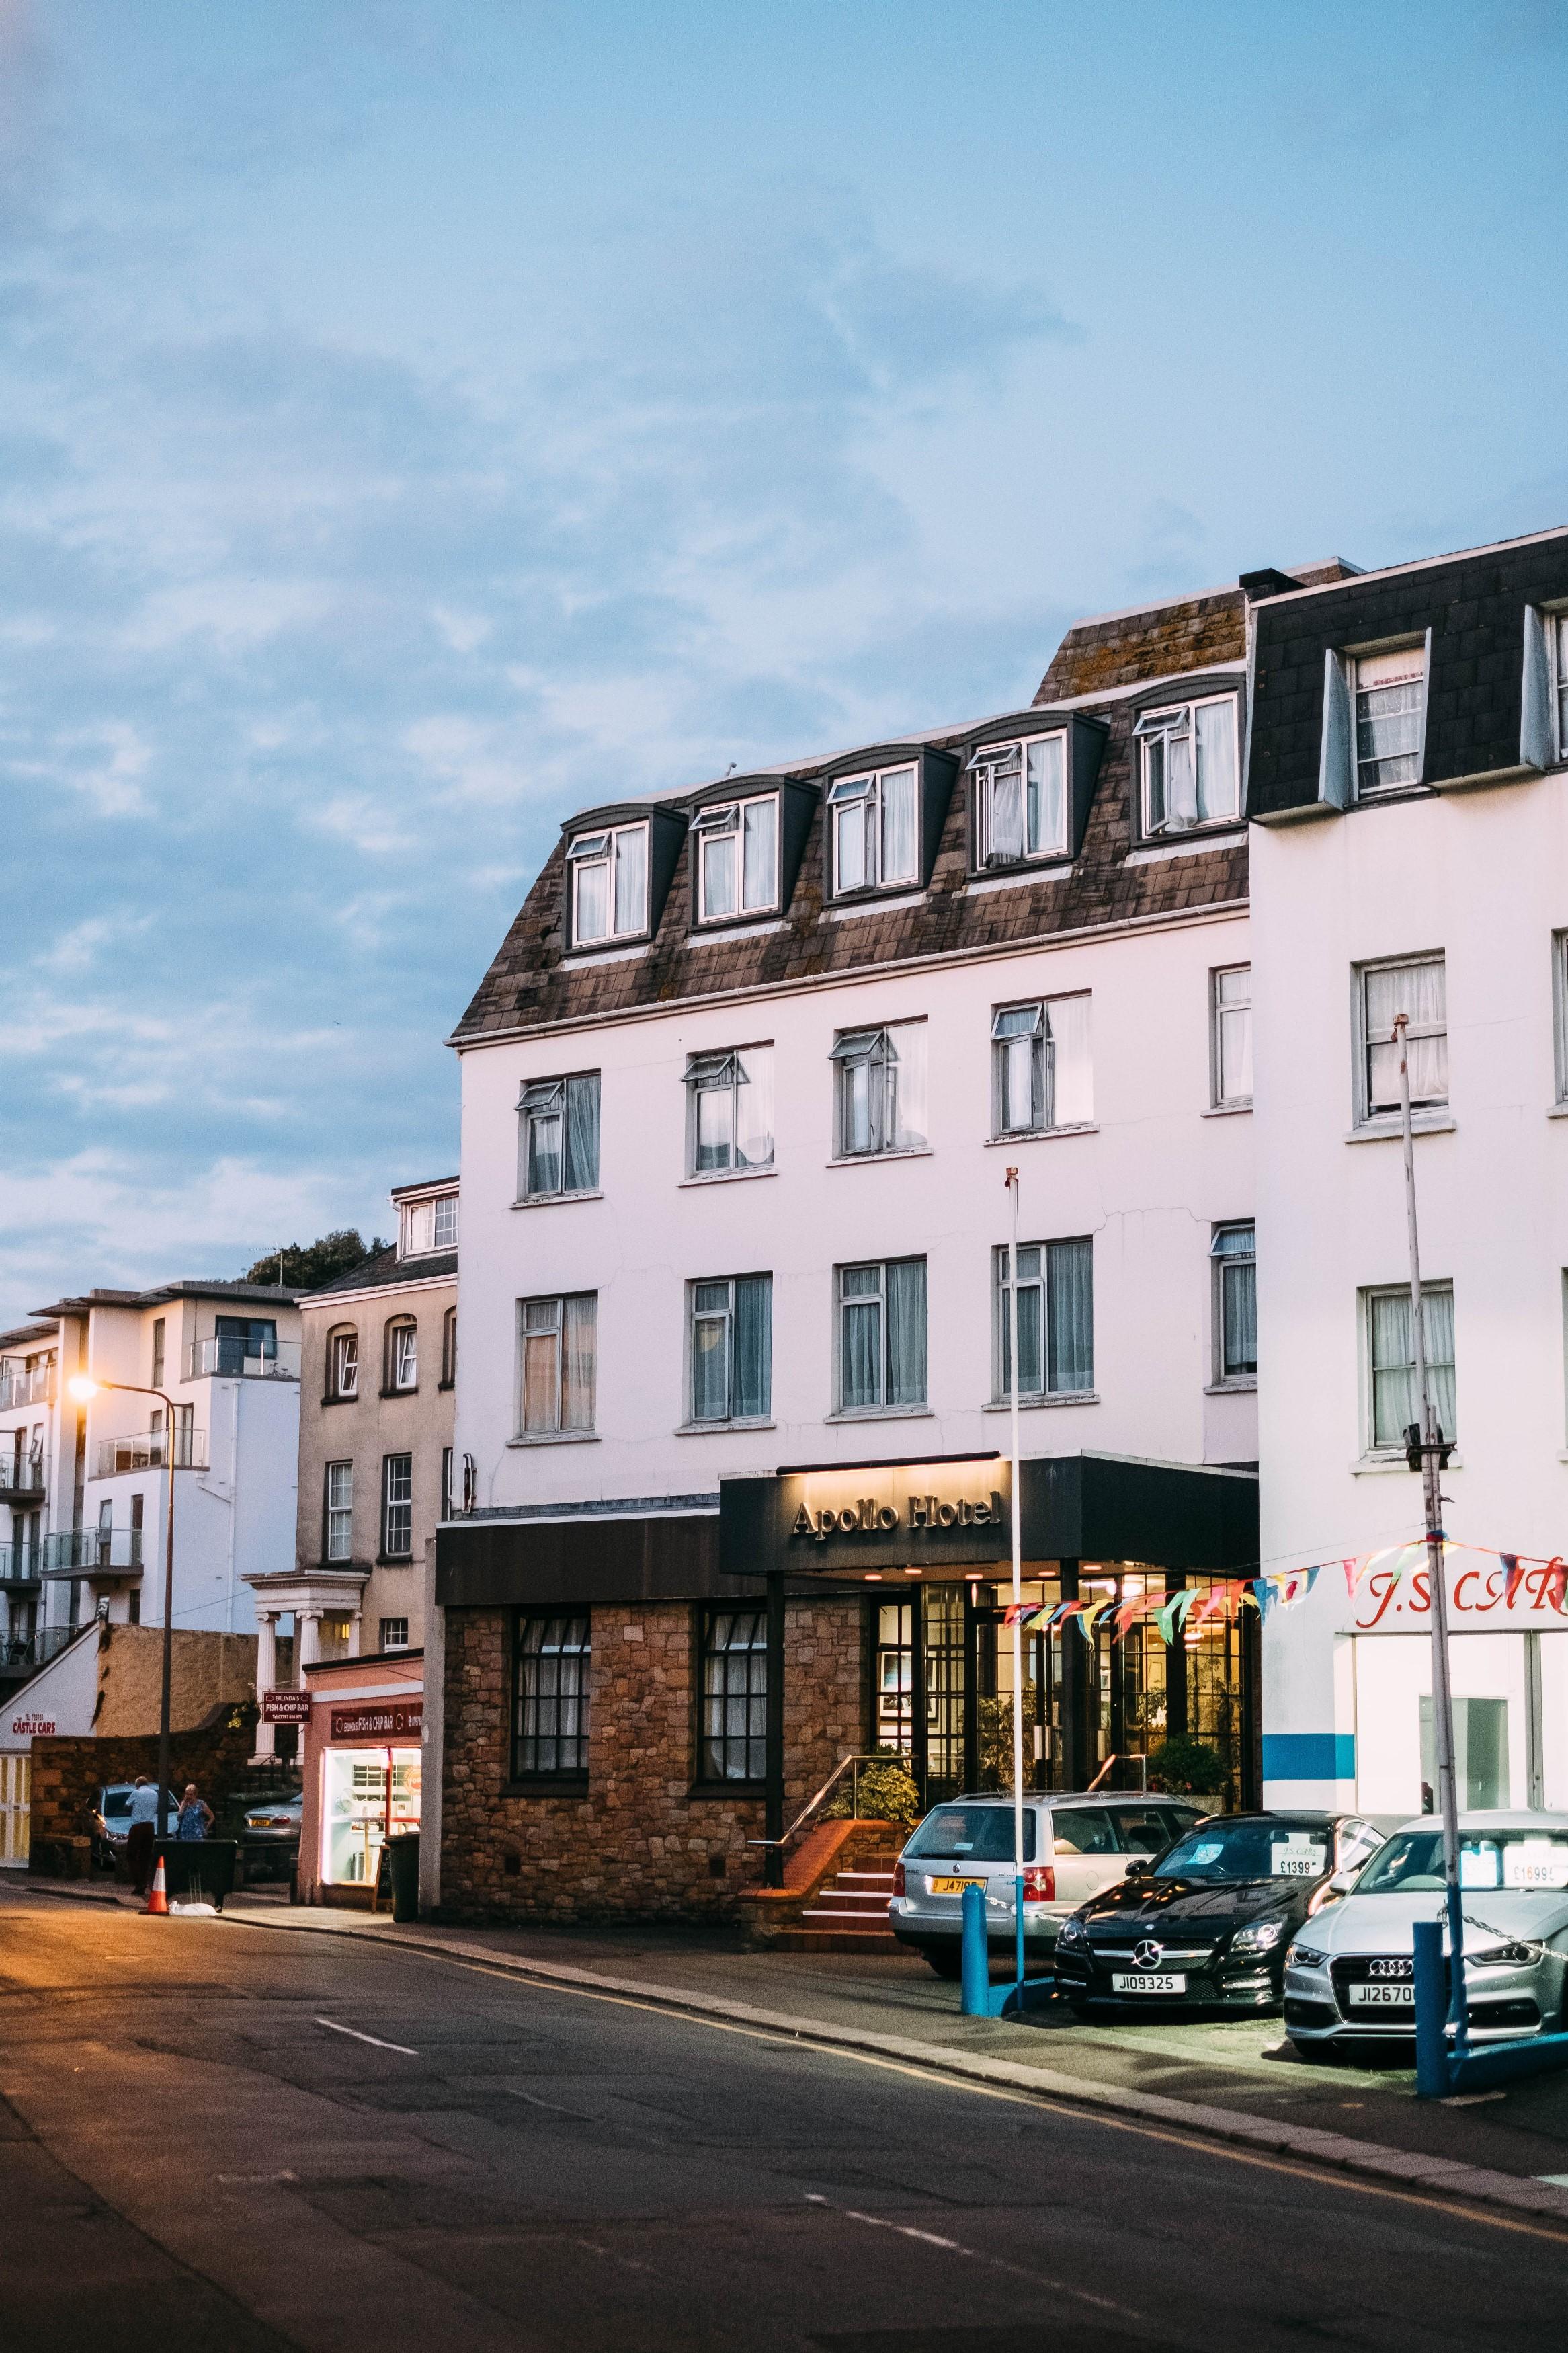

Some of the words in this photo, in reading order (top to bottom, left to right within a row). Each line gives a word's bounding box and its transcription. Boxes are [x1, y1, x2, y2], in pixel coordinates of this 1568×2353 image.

[789, 1498, 899, 1540] Apollo
[907, 1491, 1001, 1528] Hotel
[266, 1704, 279, 1712] FISH
[279, 1704, 284, 1712] &
[284, 1704, 297, 1712] CHIP
[298, 1704, 308, 1712] BAR
[13, 1722, 36, 1734] CASTLE
[38, 1722, 56, 1734] CARS
[358, 1717, 368, 1730] FISH
[368, 1716, 372, 1730] &
[372, 1716, 384, 1730] CHIP
[384, 1715, 393, 1730] BAR
[1120, 1977, 1173, 1989] J109325
[1358, 1987, 1415, 2002] J12670
